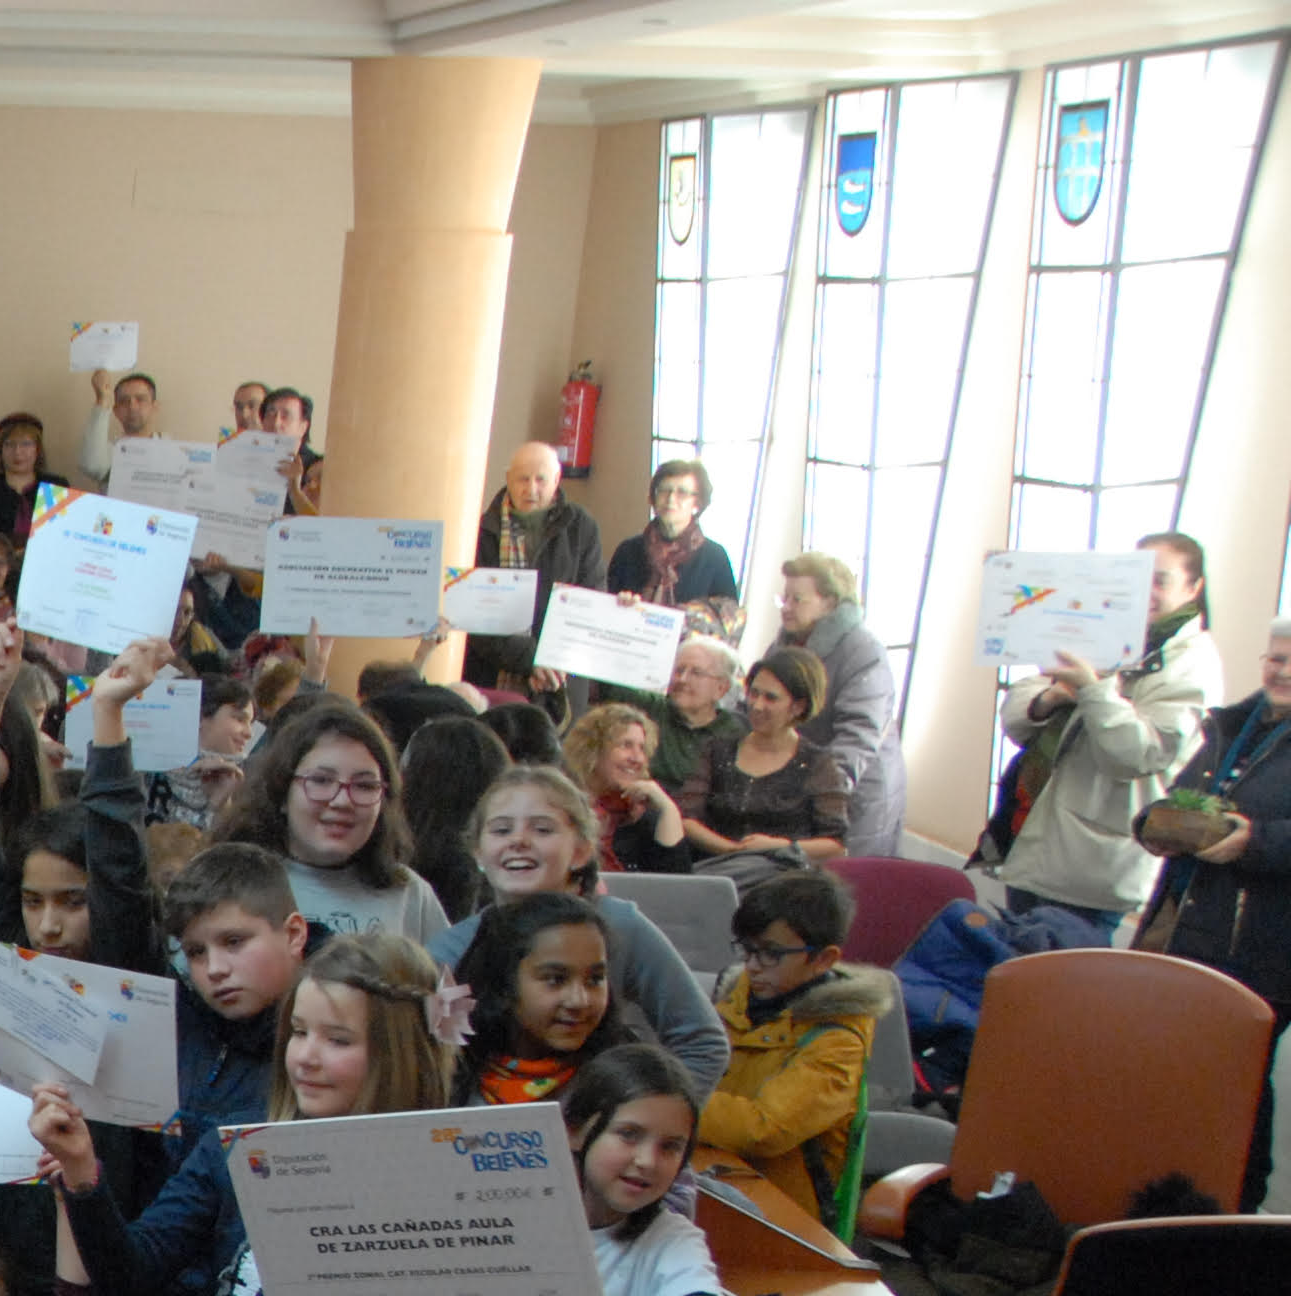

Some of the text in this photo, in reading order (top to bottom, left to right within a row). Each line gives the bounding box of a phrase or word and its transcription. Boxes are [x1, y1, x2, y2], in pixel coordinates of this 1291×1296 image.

[453, 1131, 544, 1156] CONCURSO
[472, 1149, 548, 1172] BELENES
[310, 1216, 515, 1238] CRA LAS CAÑADAS AULA
[316, 1234, 516, 1254] DE ZARZUELA DE PINAR
